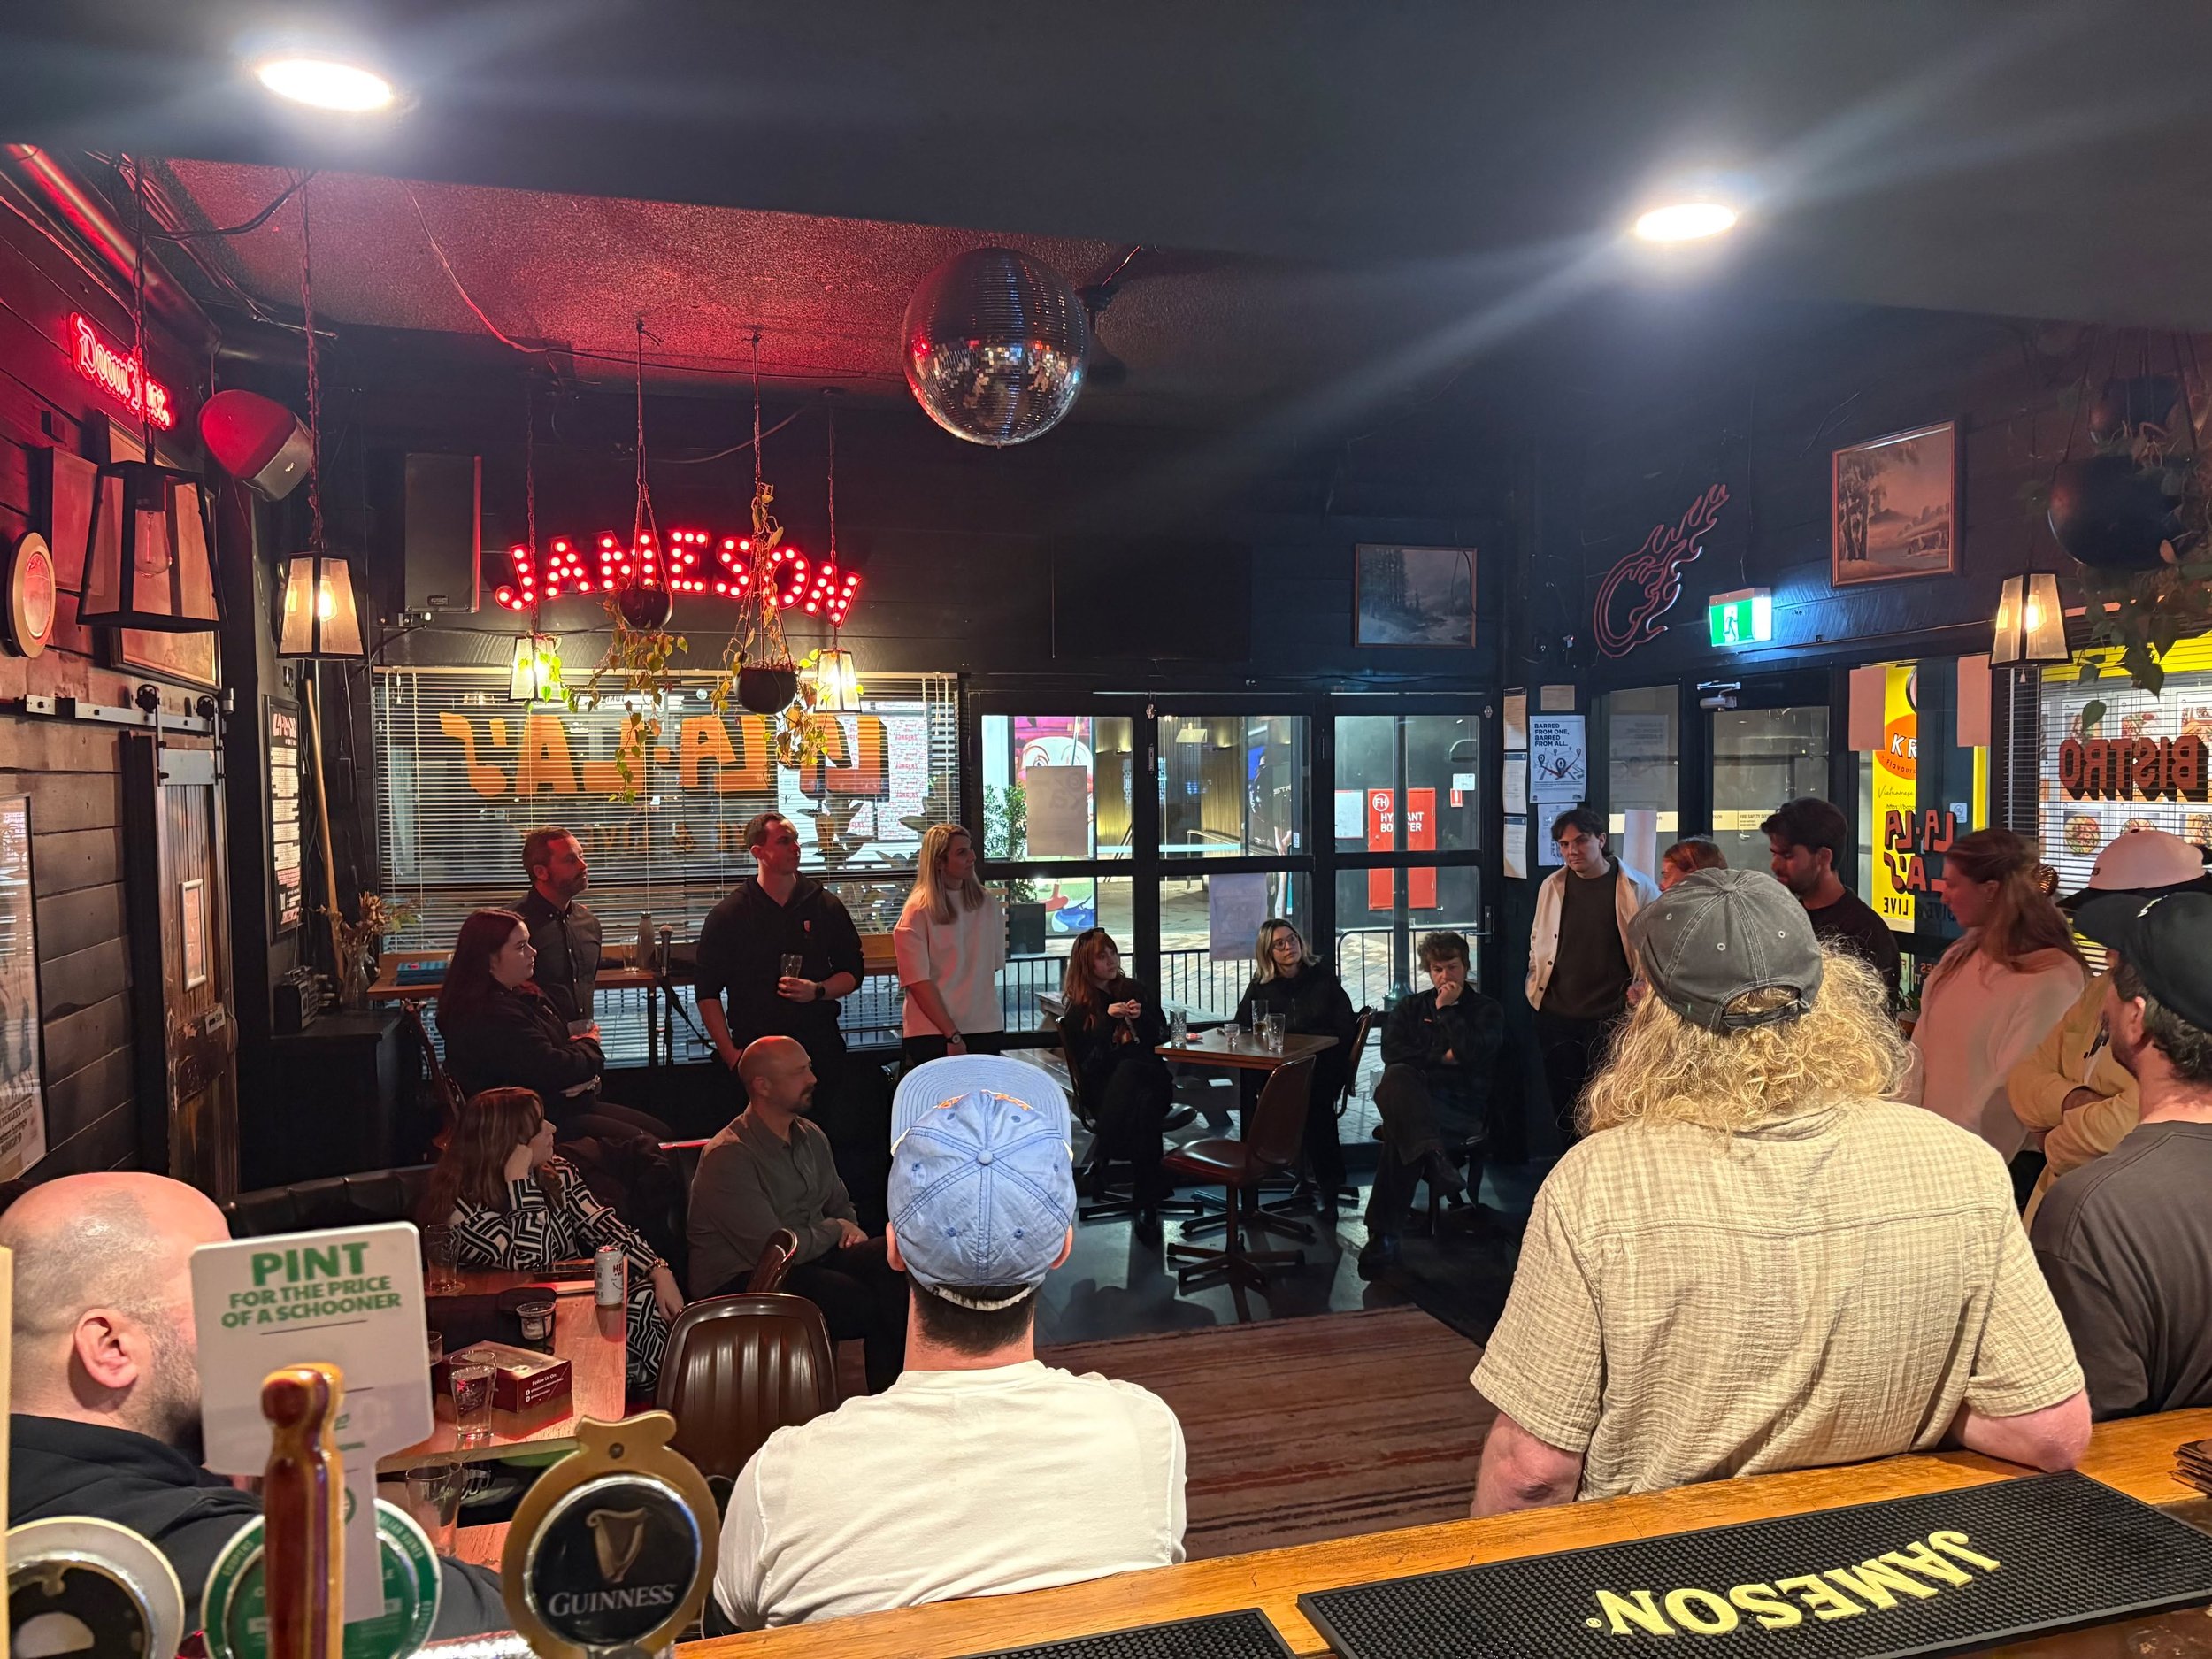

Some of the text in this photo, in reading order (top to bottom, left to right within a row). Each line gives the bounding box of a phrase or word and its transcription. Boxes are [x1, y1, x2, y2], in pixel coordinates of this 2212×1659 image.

[495, 528, 864, 630] JAMESON
[1380, 811, 1424, 822] HYANT
[250, 1241, 369, 1286] PINT
[228, 1275, 392, 1310] FOR THE PRICE
[220, 1293, 402, 1329] OF A SCHOONER
[548, 1583, 680, 1617] GUINNESS
[1594, 1530, 2001, 1636] JAMESON
